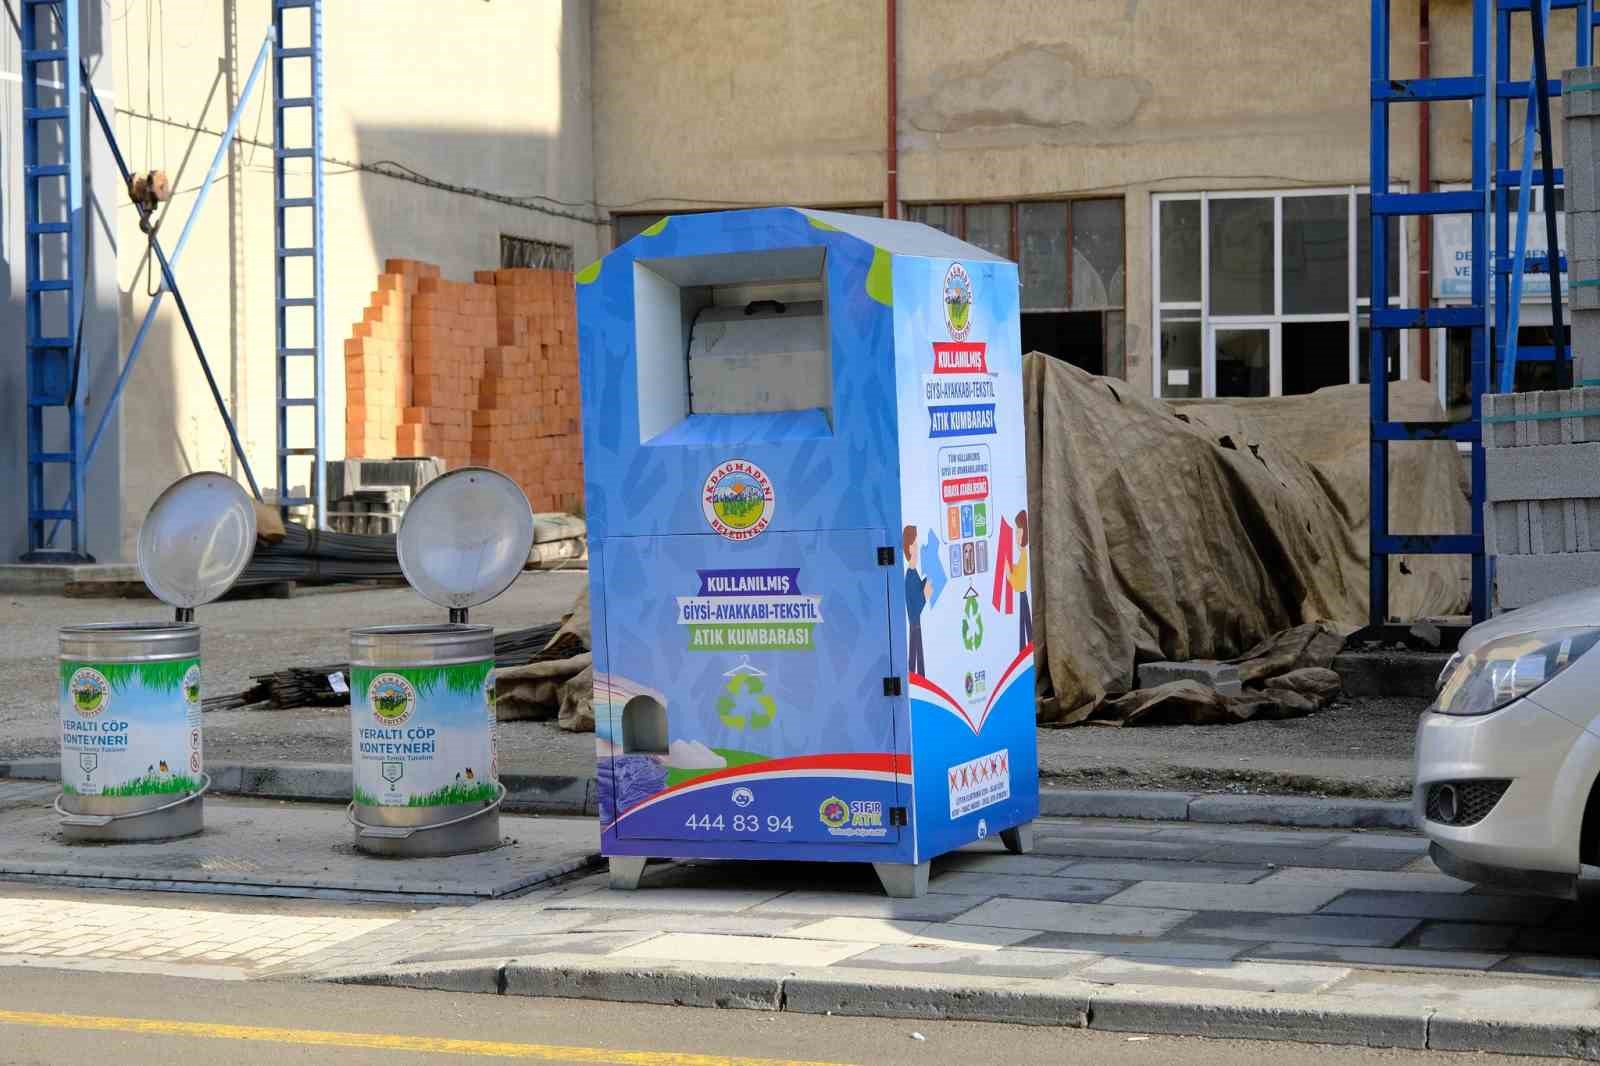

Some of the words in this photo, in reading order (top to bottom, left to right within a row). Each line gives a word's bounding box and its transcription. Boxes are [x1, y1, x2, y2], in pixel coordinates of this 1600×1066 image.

[932, 412, 948, 432] ATIK
[951, 409, 993, 430] KUMBARASI
[707, 576, 790, 594] KULLANILMIŞ
[683, 599, 817, 621] GİYSİ-AYAKKABI-TEKSTİL
[694, 630, 727, 645] ATIK
[728, 628, 809, 645] KUMBARASI
[101, 719, 129, 734] ÇÖP
[359, 728, 402, 740] YERALTI
[407, 726, 436, 742] ÇÖP
[359, 740, 436, 754] KONTEYNERİ
[851, 802, 881, 813] SIFIR
[685, 813, 726, 832] 444
[732, 814, 760, 832] 83
[767, 814, 795, 833] 94
